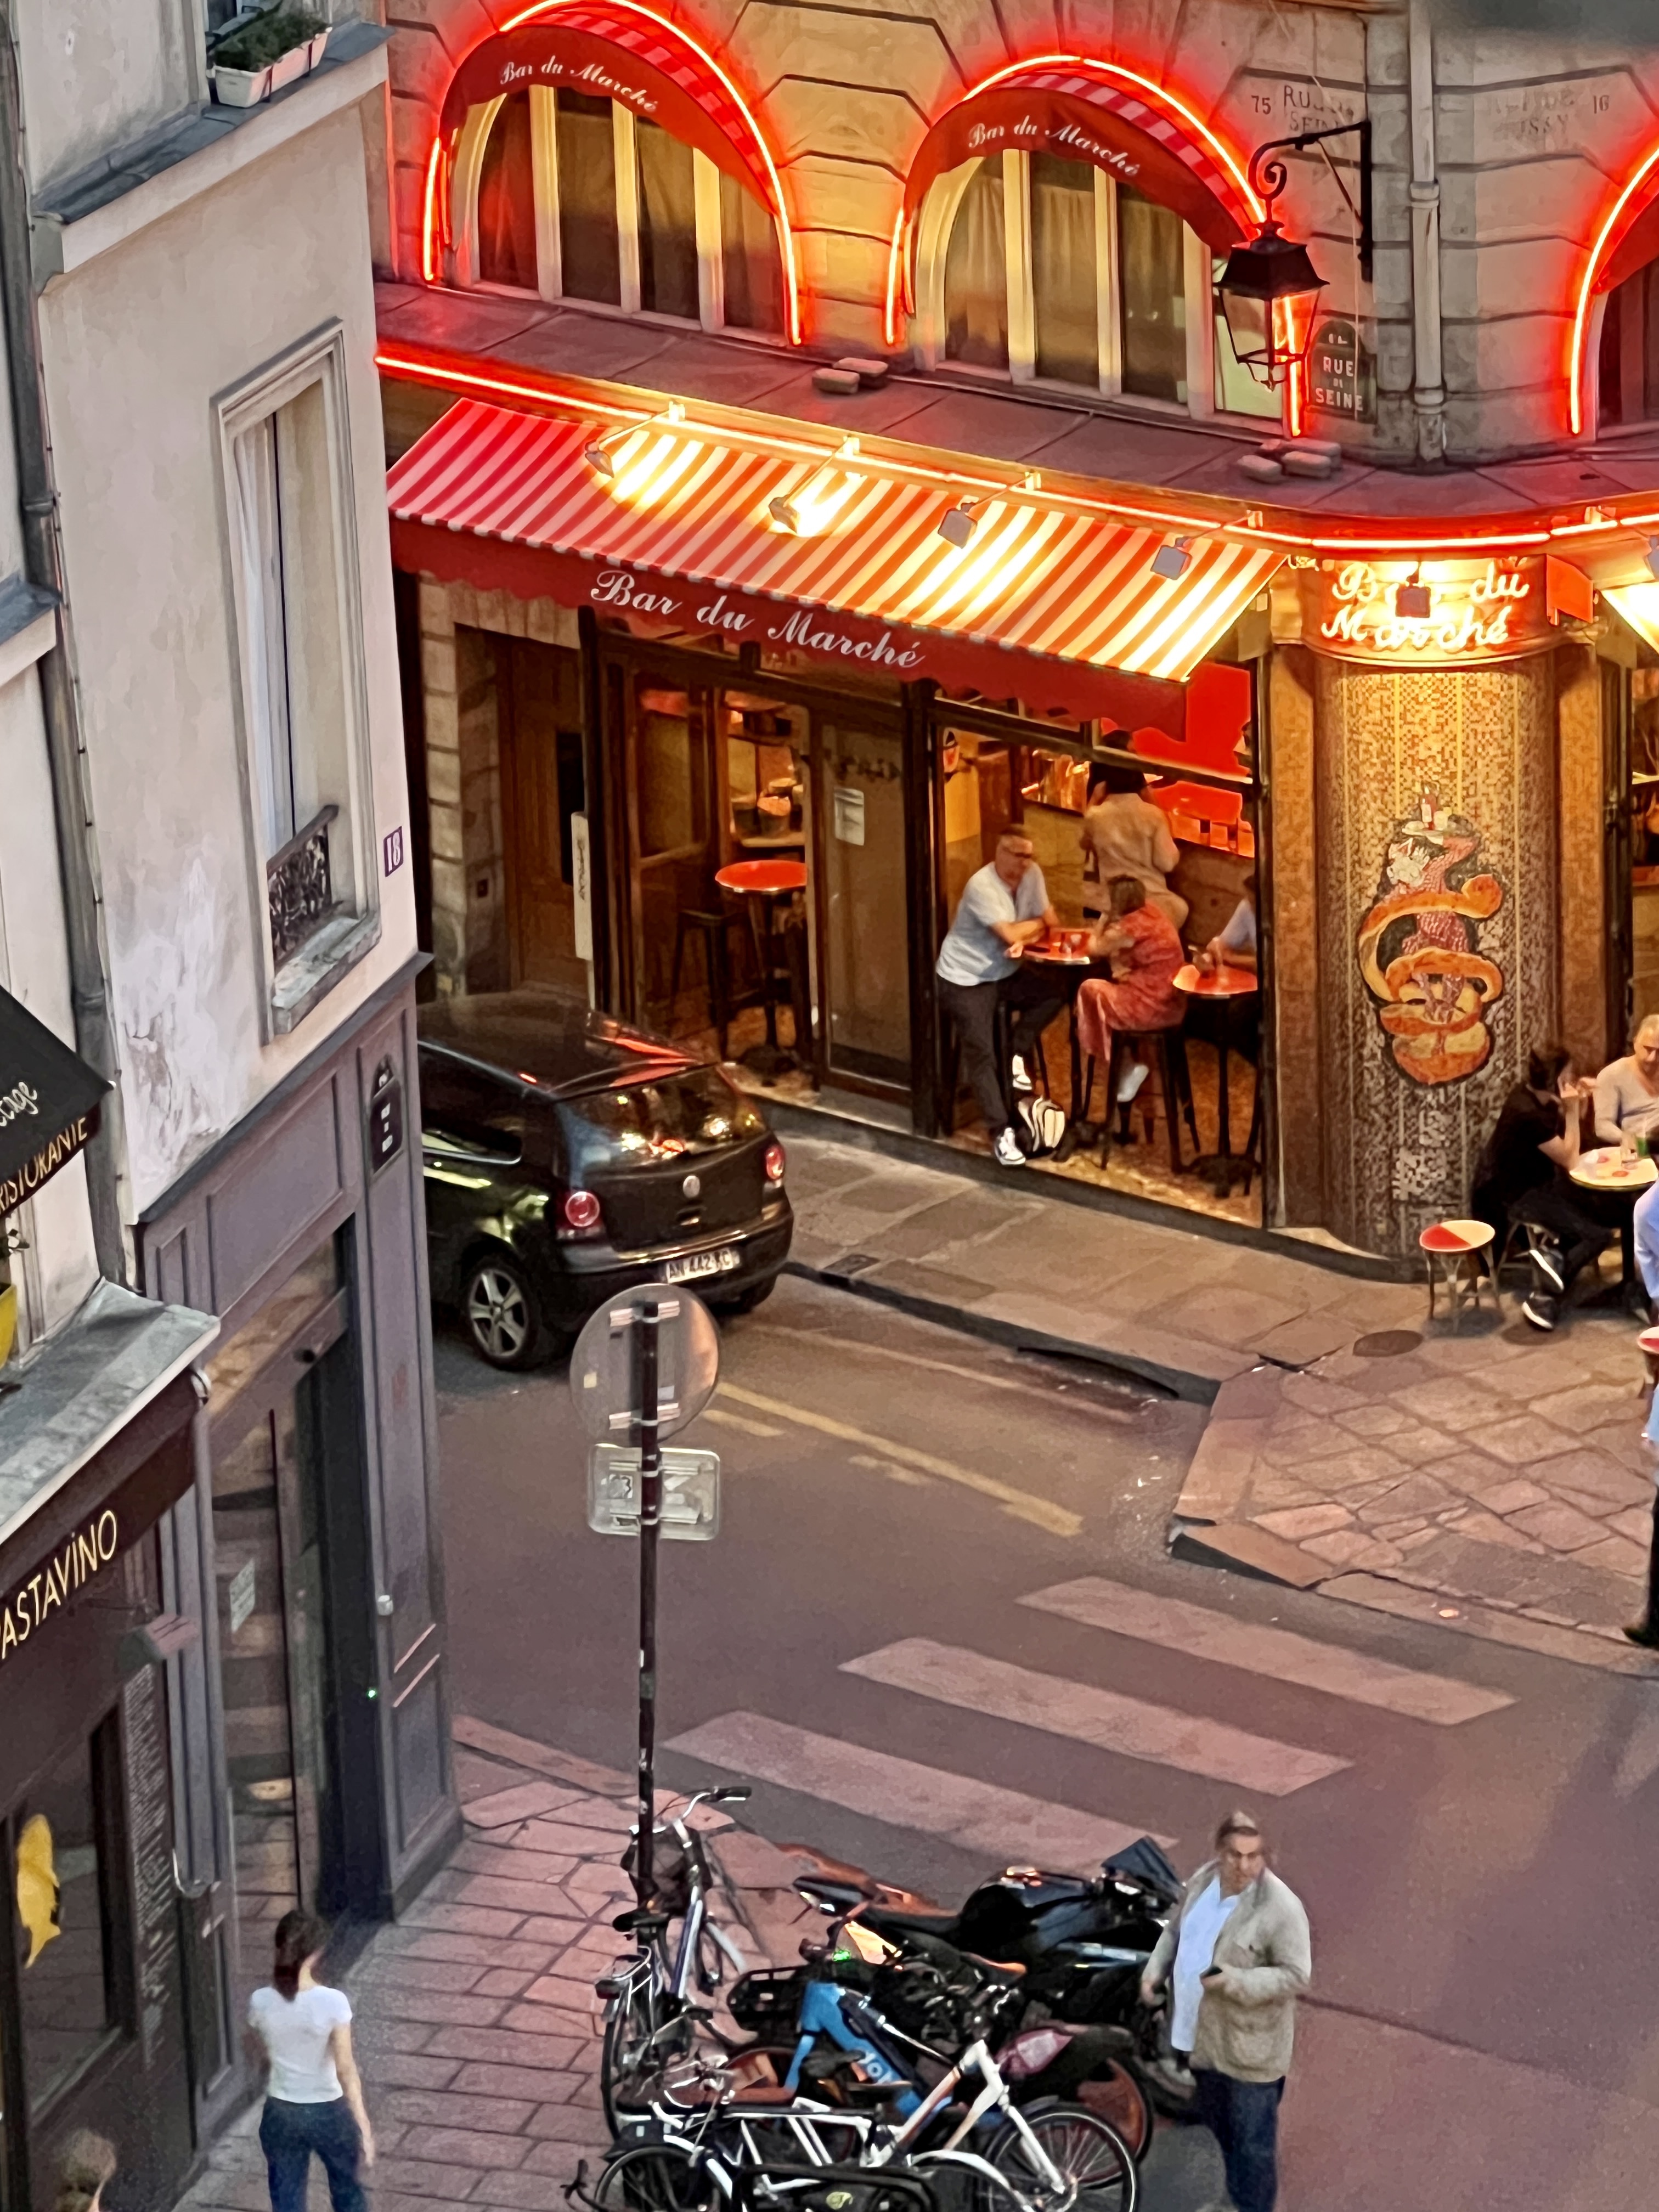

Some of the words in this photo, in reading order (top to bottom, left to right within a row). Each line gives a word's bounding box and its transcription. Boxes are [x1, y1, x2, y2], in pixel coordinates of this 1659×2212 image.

[500, 61, 532, 84] Bar
[541, 55, 563, 74] du
[1251, 94, 1271, 115] 75
[1284, 85, 1323, 112] RU
[968, 122, 1005, 148] Bar
[1014, 115, 1037, 135] du
[1323, 356, 1353, 376] RUE
[1316, 387, 1363, 411] SEINE
[1470, 561, 1530, 603] du
[590, 570, 682, 614] Bar
[696, 595, 755, 631] du
[768, 610, 926, 668] Marché
[0, 1510, 116, 1660] ASTAVINO
